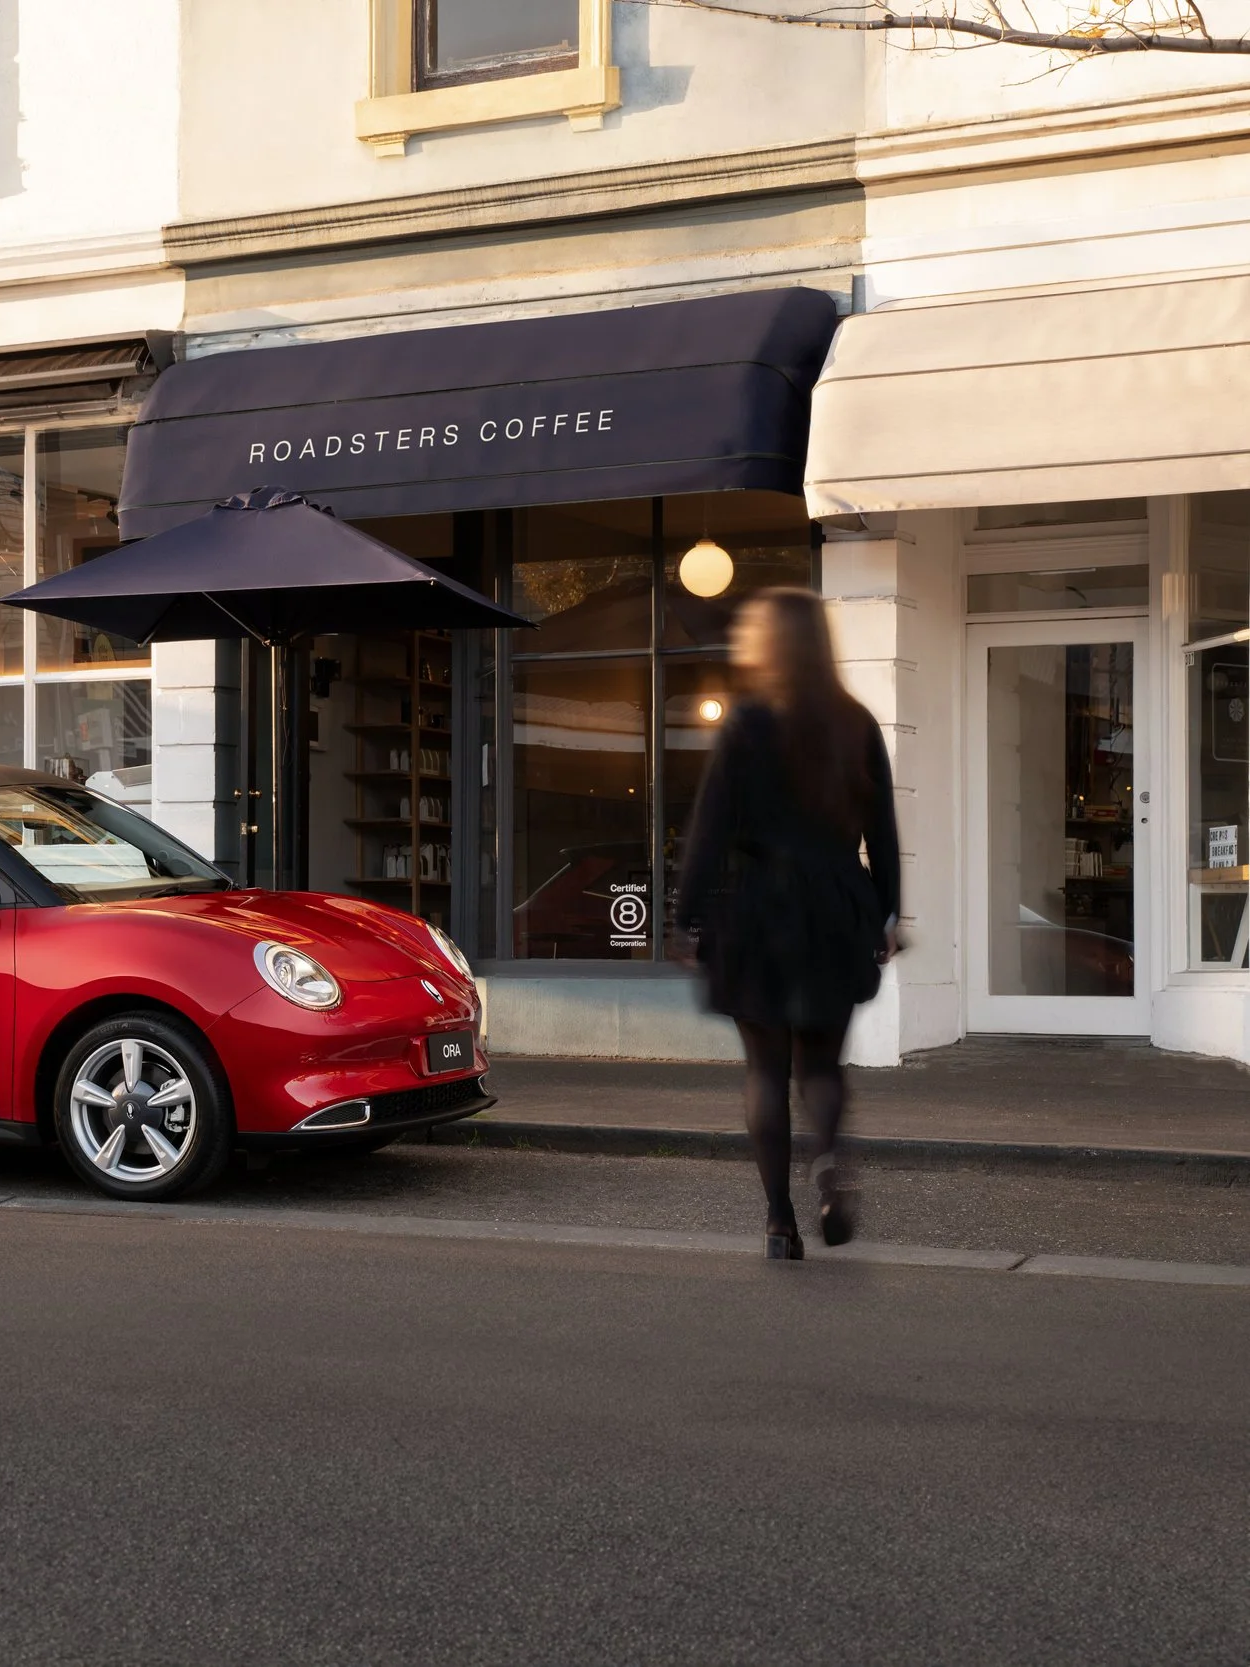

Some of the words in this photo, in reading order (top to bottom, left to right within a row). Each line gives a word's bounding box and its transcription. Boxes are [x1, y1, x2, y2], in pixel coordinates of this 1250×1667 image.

[248, 424, 459, 465] ROADSTERS
[479, 409, 614, 443] COFFEE
[1211, 844, 1237, 857] BREAKFAST
[610, 883, 647, 893] Certified
[610, 940, 647, 948] Corporation
[442, 1043, 462, 1058] ORA
